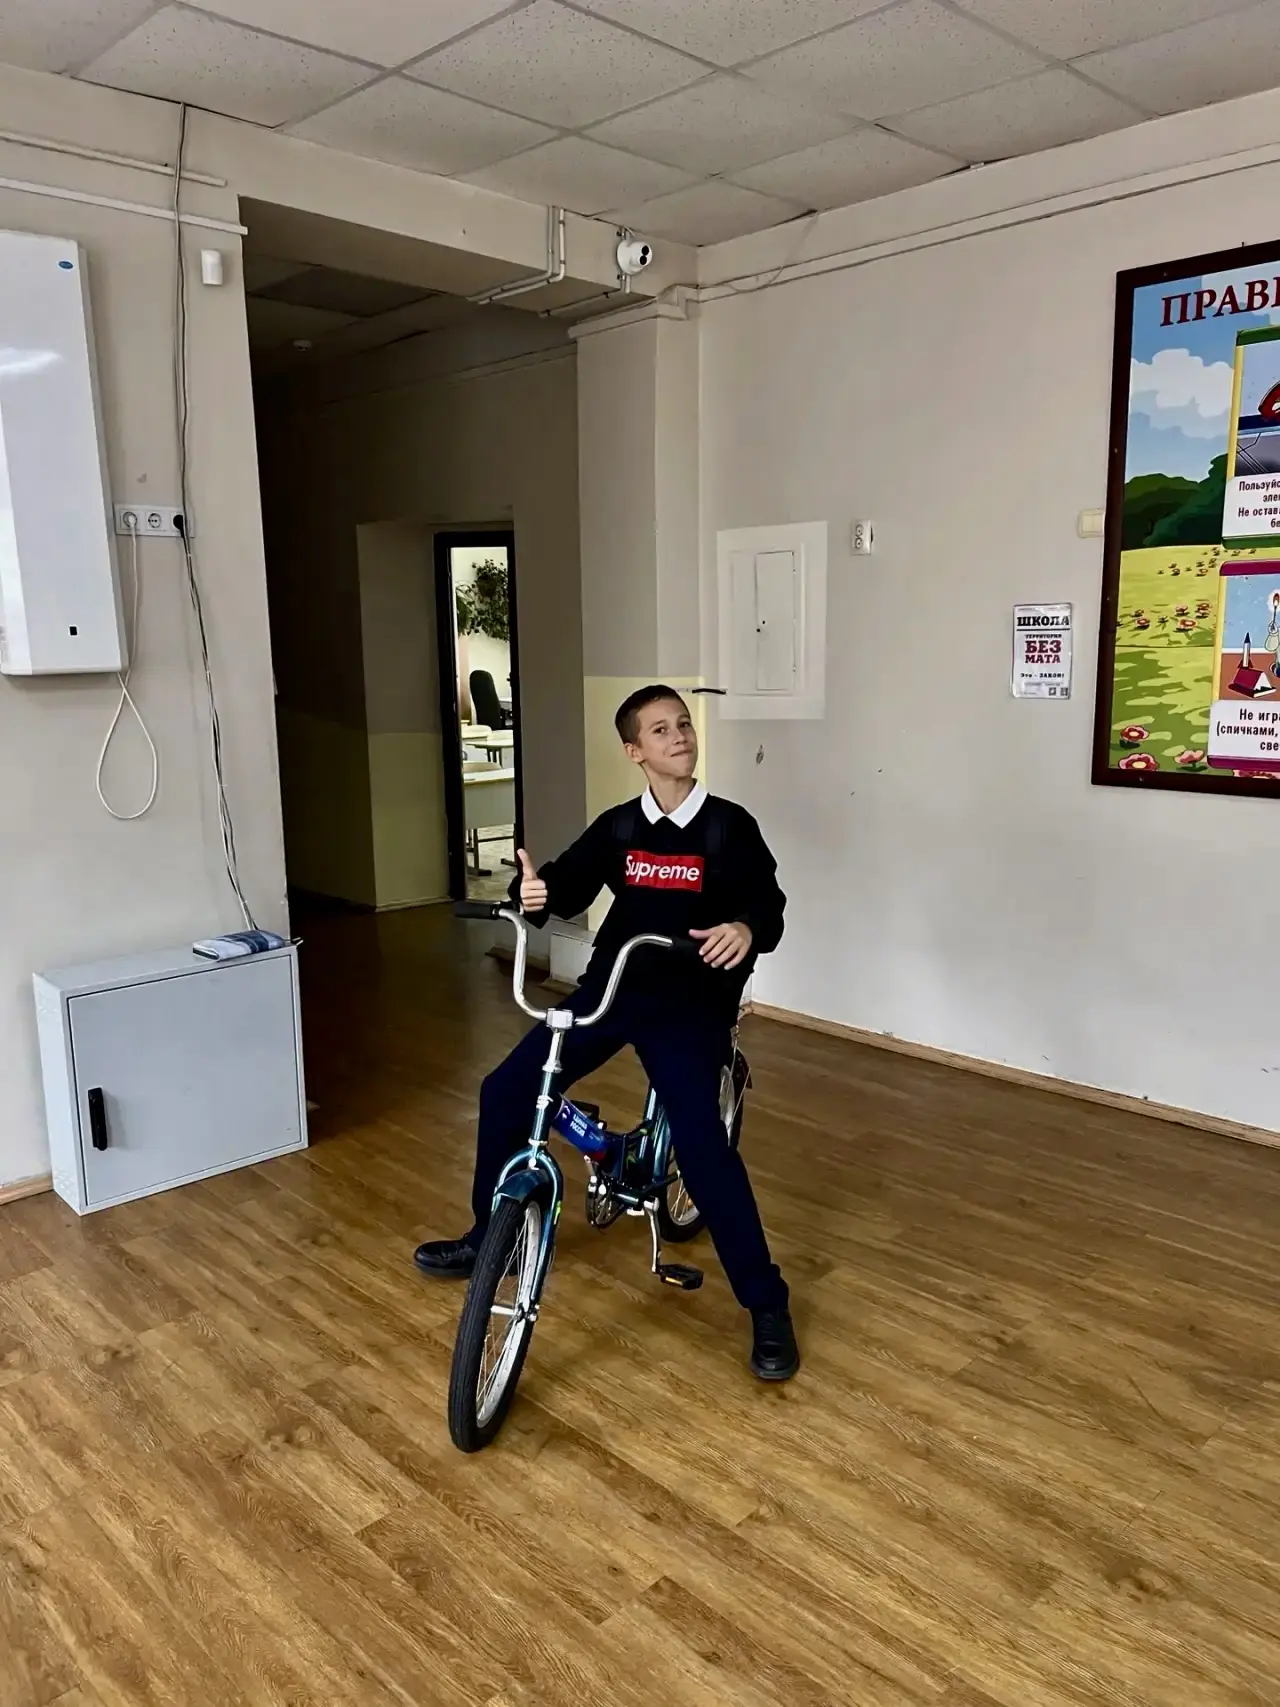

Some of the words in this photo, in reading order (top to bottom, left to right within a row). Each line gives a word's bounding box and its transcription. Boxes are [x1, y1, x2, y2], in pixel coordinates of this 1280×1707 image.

[1262, 494, 1280, 503] эле
[1238, 507, 1250, 517] Не
[1252, 507, 1280, 517] остав
[1016, 615, 1070, 627] ШКОЛА
[1024, 640, 1062, 654] БЕЗ
[1024, 654, 1062, 664] МАТА
[1239, 708, 1254, 721] Не
[1258, 712, 1280, 724] игр
[1216, 720, 1279, 737] (спичками,
[1259, 741, 1279, 751] све
[625, 855, 700, 883] Supreme
